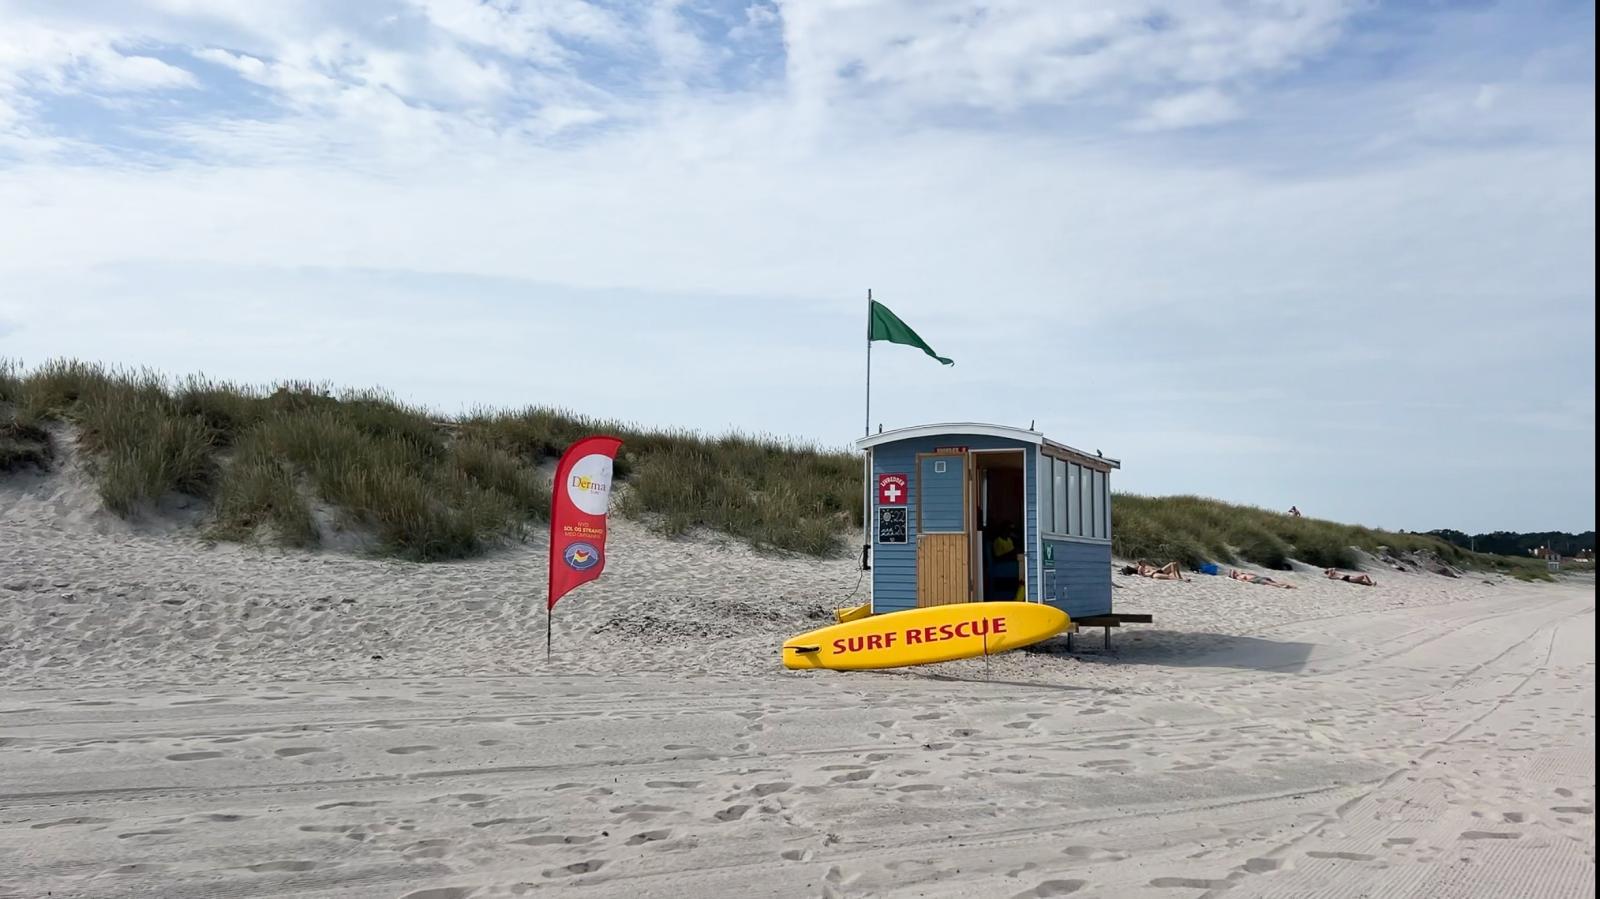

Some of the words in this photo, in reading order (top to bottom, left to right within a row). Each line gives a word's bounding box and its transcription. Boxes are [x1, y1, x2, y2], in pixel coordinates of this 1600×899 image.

[572, 476, 606, 491] Derma
[833, 632, 897, 654] SURF
[906, 617, 1007, 645] RESCUE
